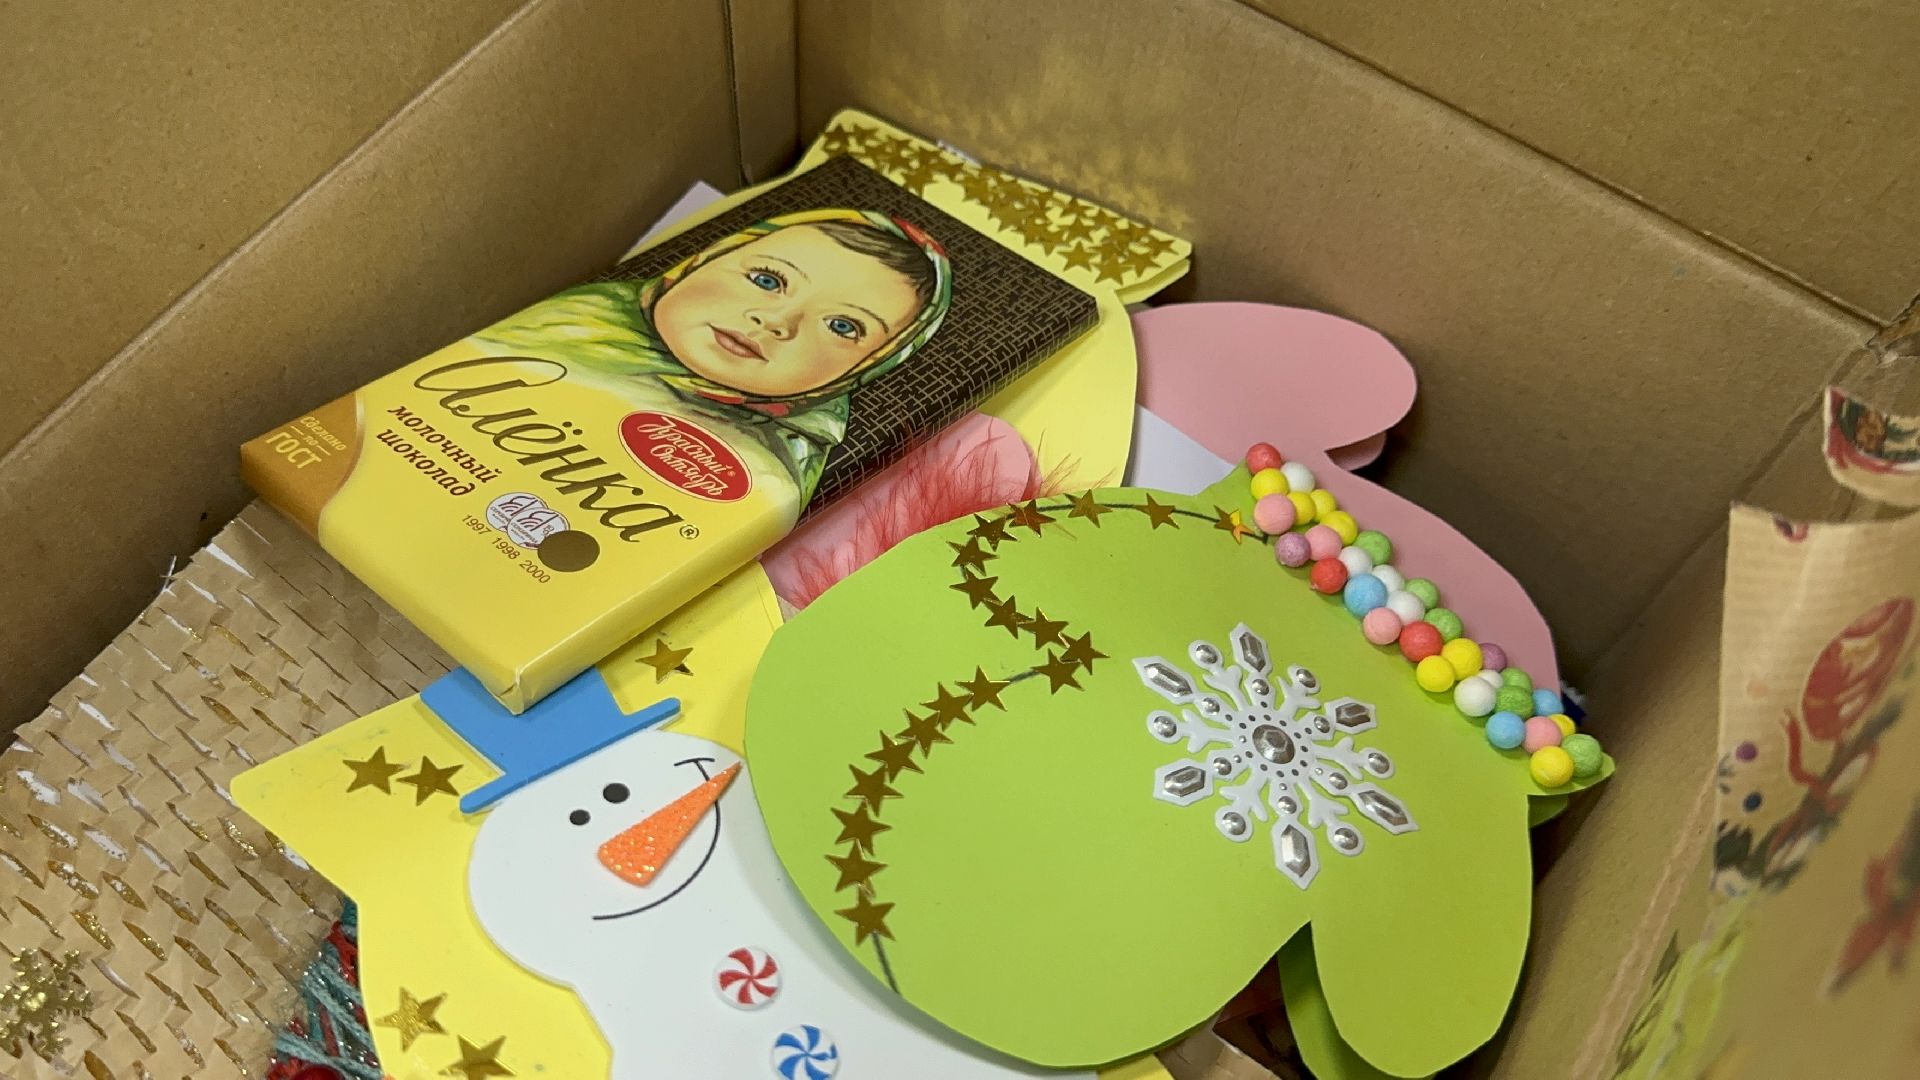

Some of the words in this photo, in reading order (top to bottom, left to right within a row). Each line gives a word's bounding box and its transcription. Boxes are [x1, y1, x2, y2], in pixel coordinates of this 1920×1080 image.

[266, 431, 323, 470] ГОСТ
[377, 428, 477, 496] шоколад
[388, 405, 502, 482] молочный
[413, 356, 683, 543] Алёнка
[636, 416, 729, 475] Красный
[650, 444, 728, 496] Октябрь
[462, 513, 492, 536] 1997
[491, 537, 521, 560] 1998
[519, 559, 551, 584] 2000
